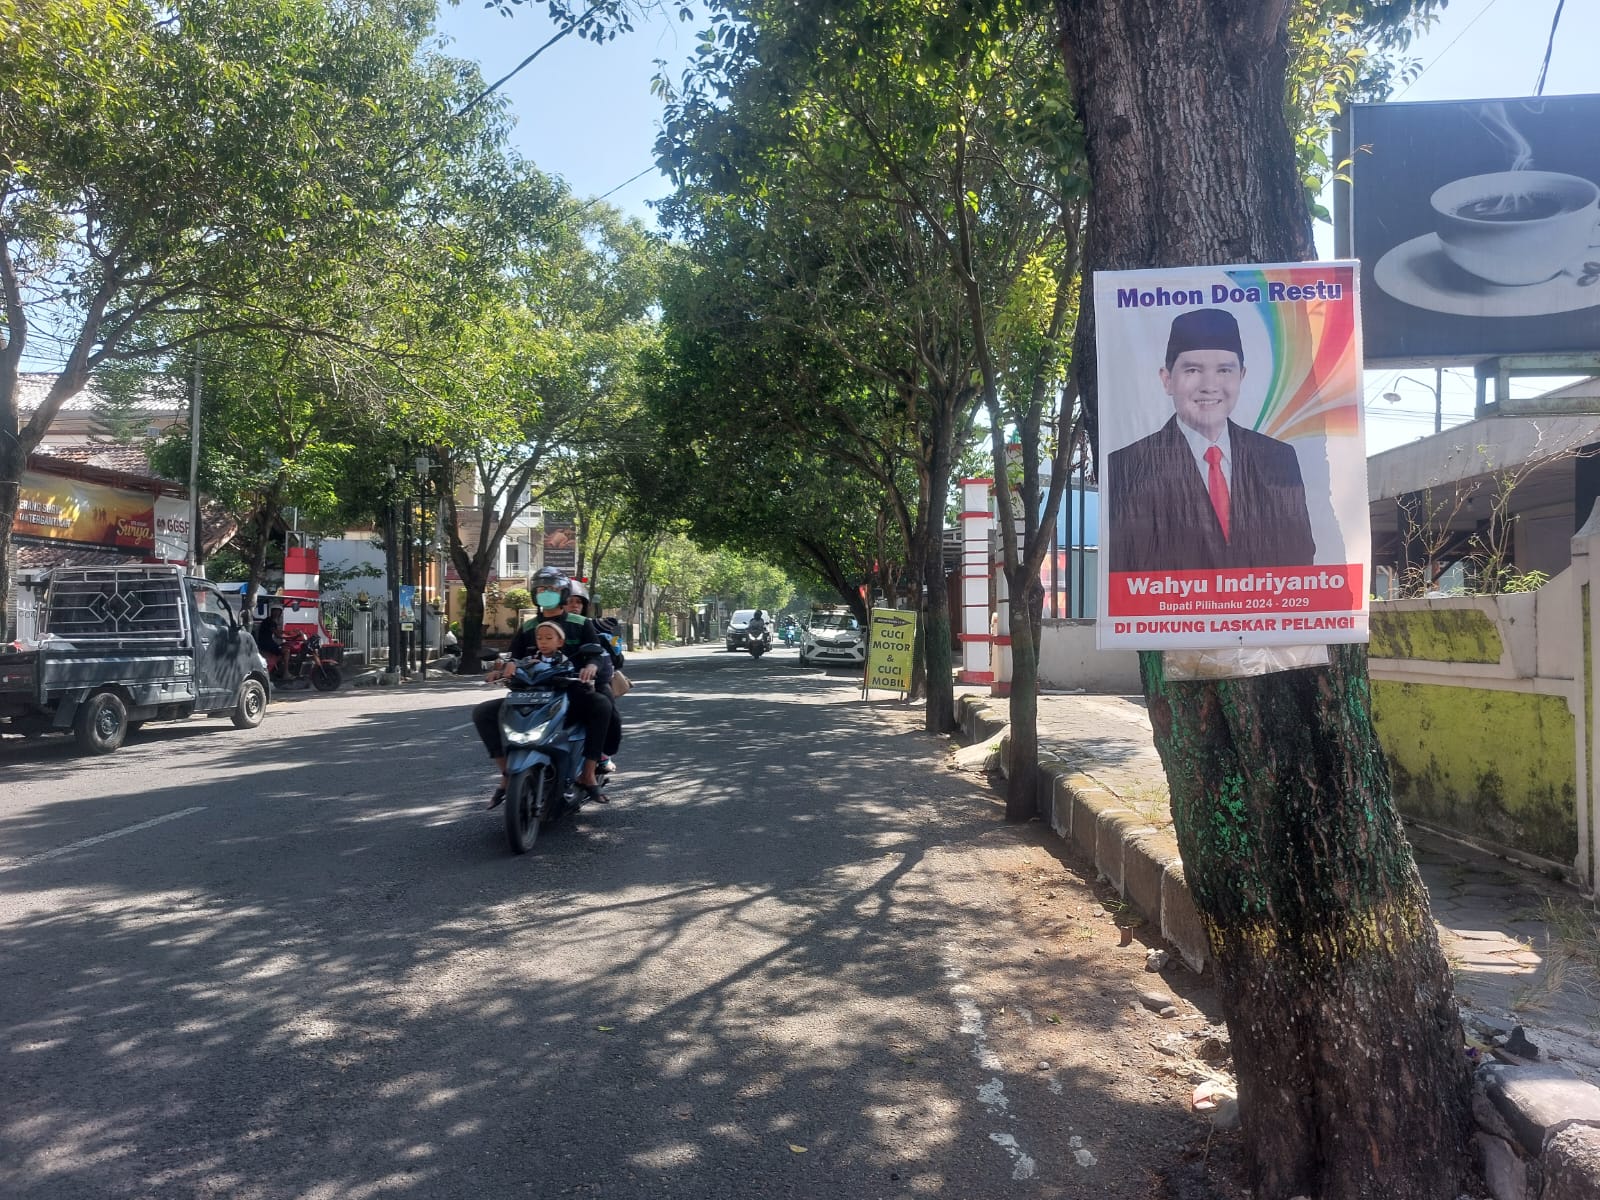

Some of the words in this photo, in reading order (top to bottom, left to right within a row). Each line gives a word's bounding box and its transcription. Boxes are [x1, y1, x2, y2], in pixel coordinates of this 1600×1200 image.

[1117, 287, 1204, 308] Mohon
[1211, 284, 1261, 304] Doa
[1268, 280, 1342, 302] Restu
[116, 518, 153, 545] Surya
[1127, 576, 1208, 598] Wahyu
[1216, 571, 1345, 595] Indriyanto
[1159, 601, 1193, 612] Bupati
[1195, 600, 1243, 610] Pilihanku
[1245, 599, 1273, 609] 2024
[1281, 597, 1310, 607] 2029
[1114, 621, 1132, 634] DI
[1136, 620, 1206, 634] DUKUNG
[1210, 618, 1276, 632] LASKAR
[1281, 616, 1355, 631] PELANGI
[881, 629, 904, 640] CUCI
[872, 641, 911, 652] MOTOR
[886, 654, 894, 662] &
[878, 665, 901, 675] CUCI
[872, 677, 905, 687] MOBIL
